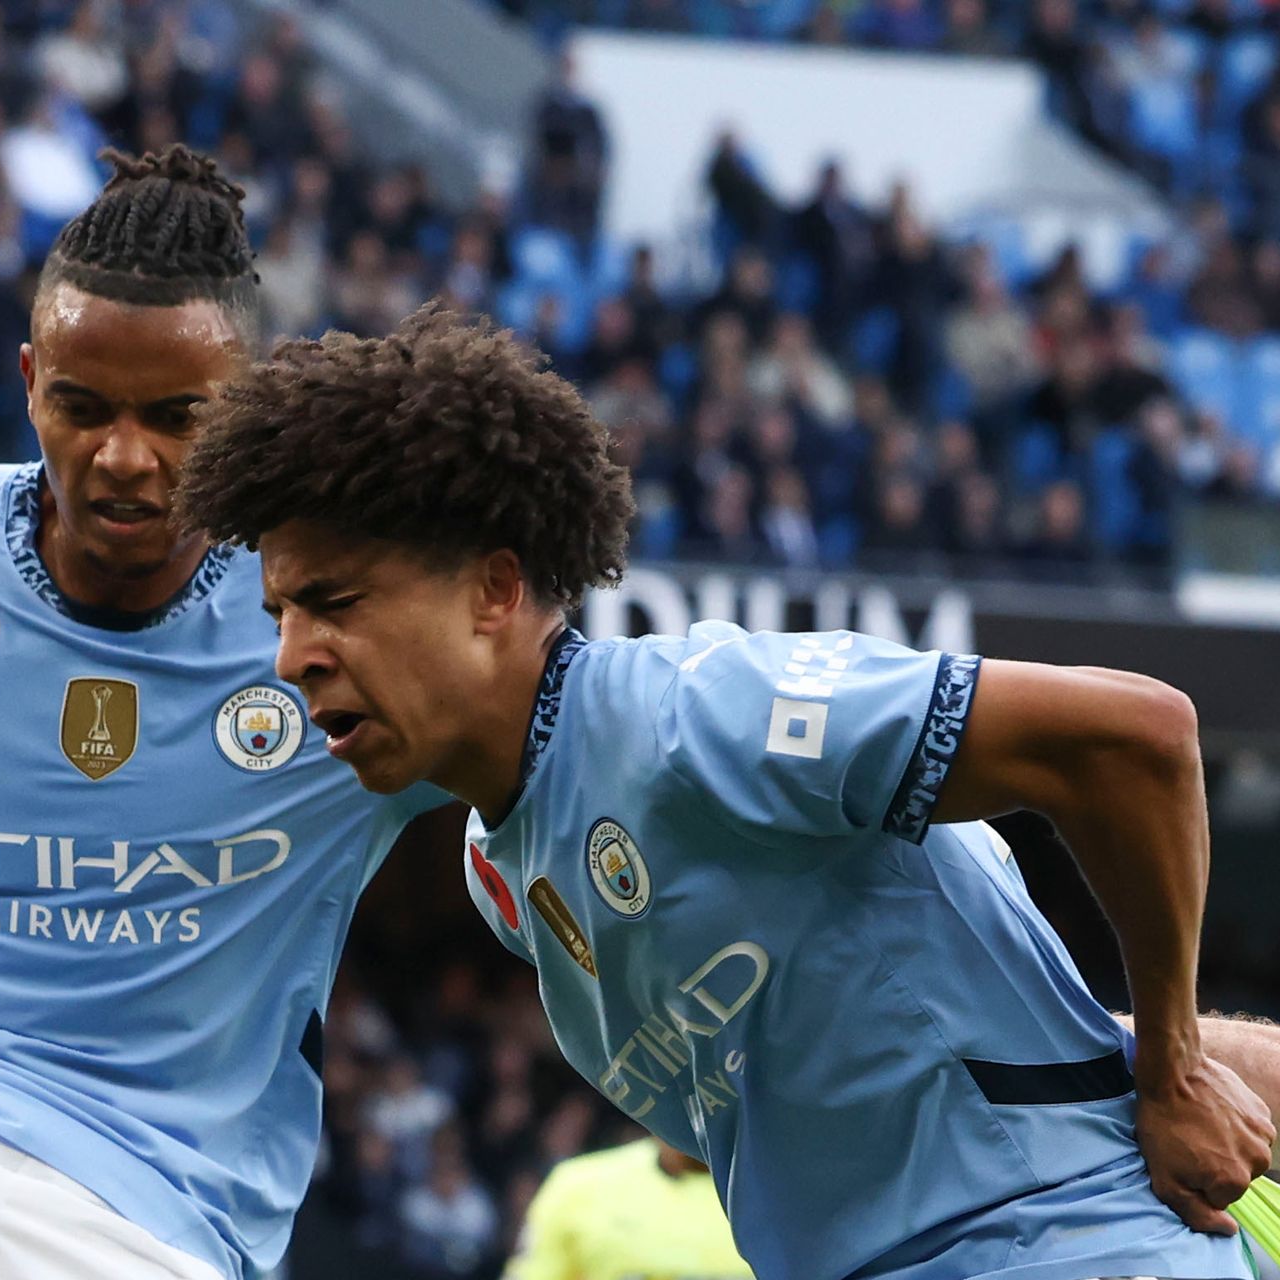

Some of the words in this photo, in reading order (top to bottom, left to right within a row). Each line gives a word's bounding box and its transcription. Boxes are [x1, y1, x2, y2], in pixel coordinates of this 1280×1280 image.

[223, 689, 296, 717] MANCHESTER
[80, 742, 114, 755] FIFA
[246, 759, 272, 768] CITY
